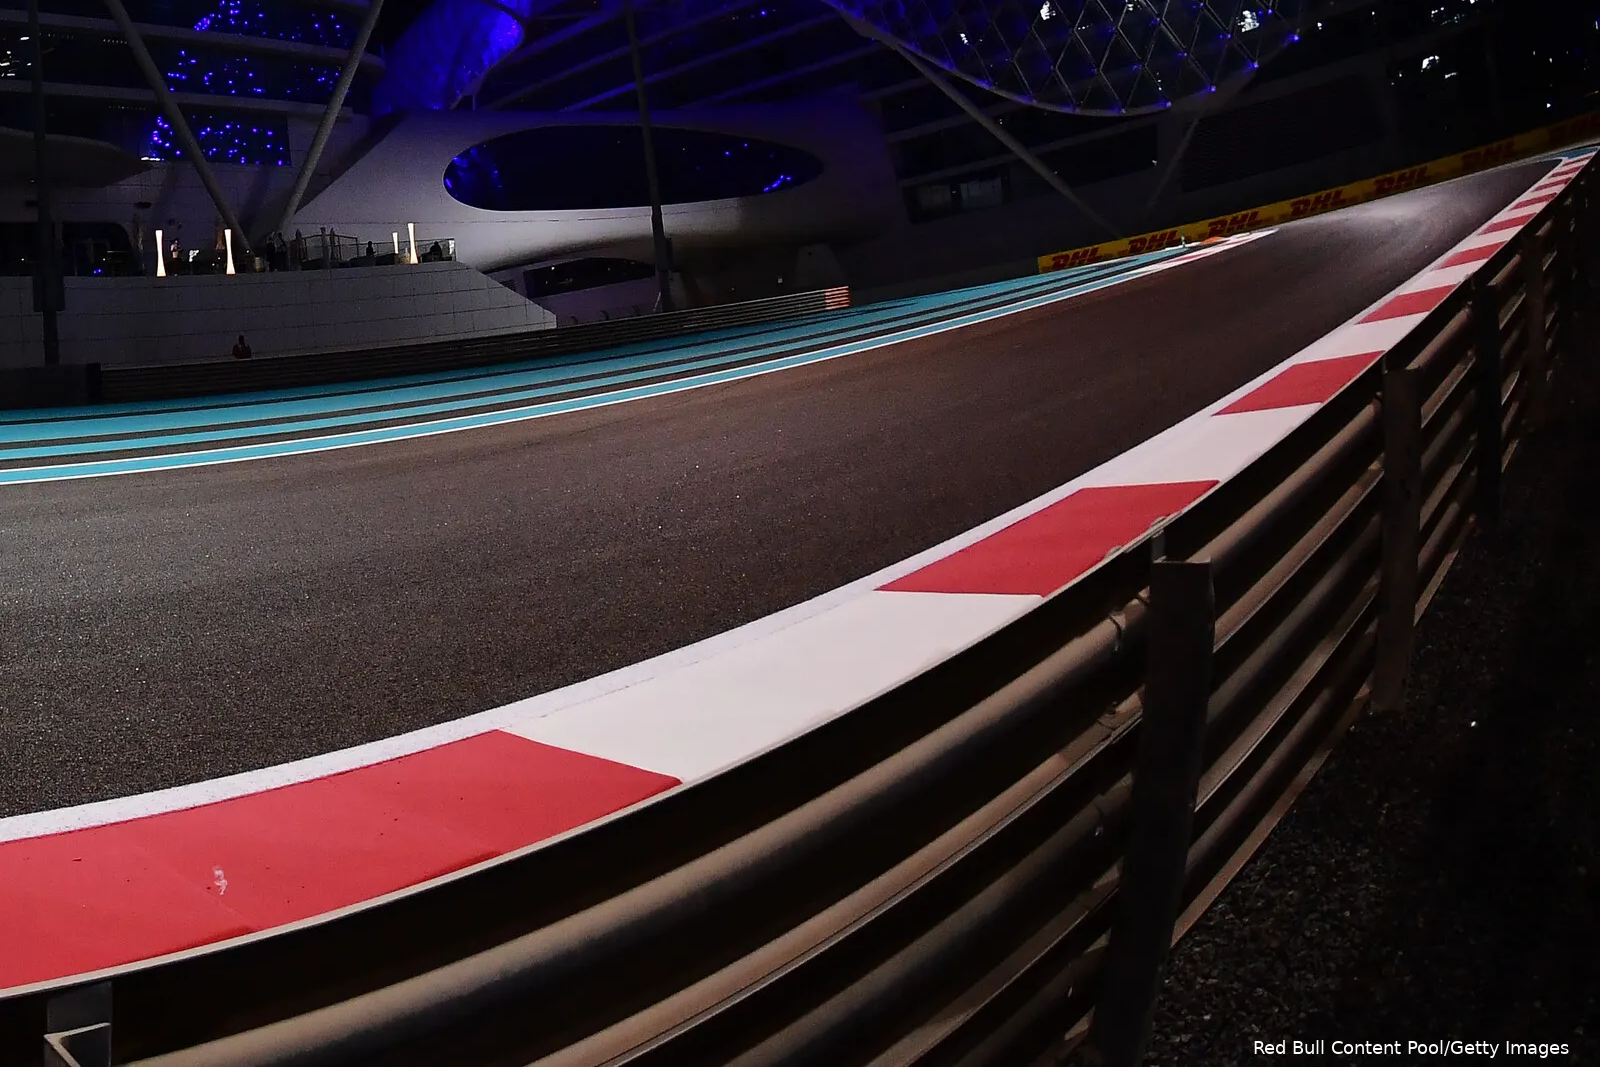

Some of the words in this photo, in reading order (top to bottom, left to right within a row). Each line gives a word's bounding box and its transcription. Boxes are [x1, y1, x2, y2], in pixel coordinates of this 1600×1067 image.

[1374, 166, 1430, 194] DHL
[1290, 190, 1346, 216] DHL
[1208, 211, 1261, 237] DHL
[1128, 230, 1182, 254] DHL
[1051, 248, 1102, 270] DHL
